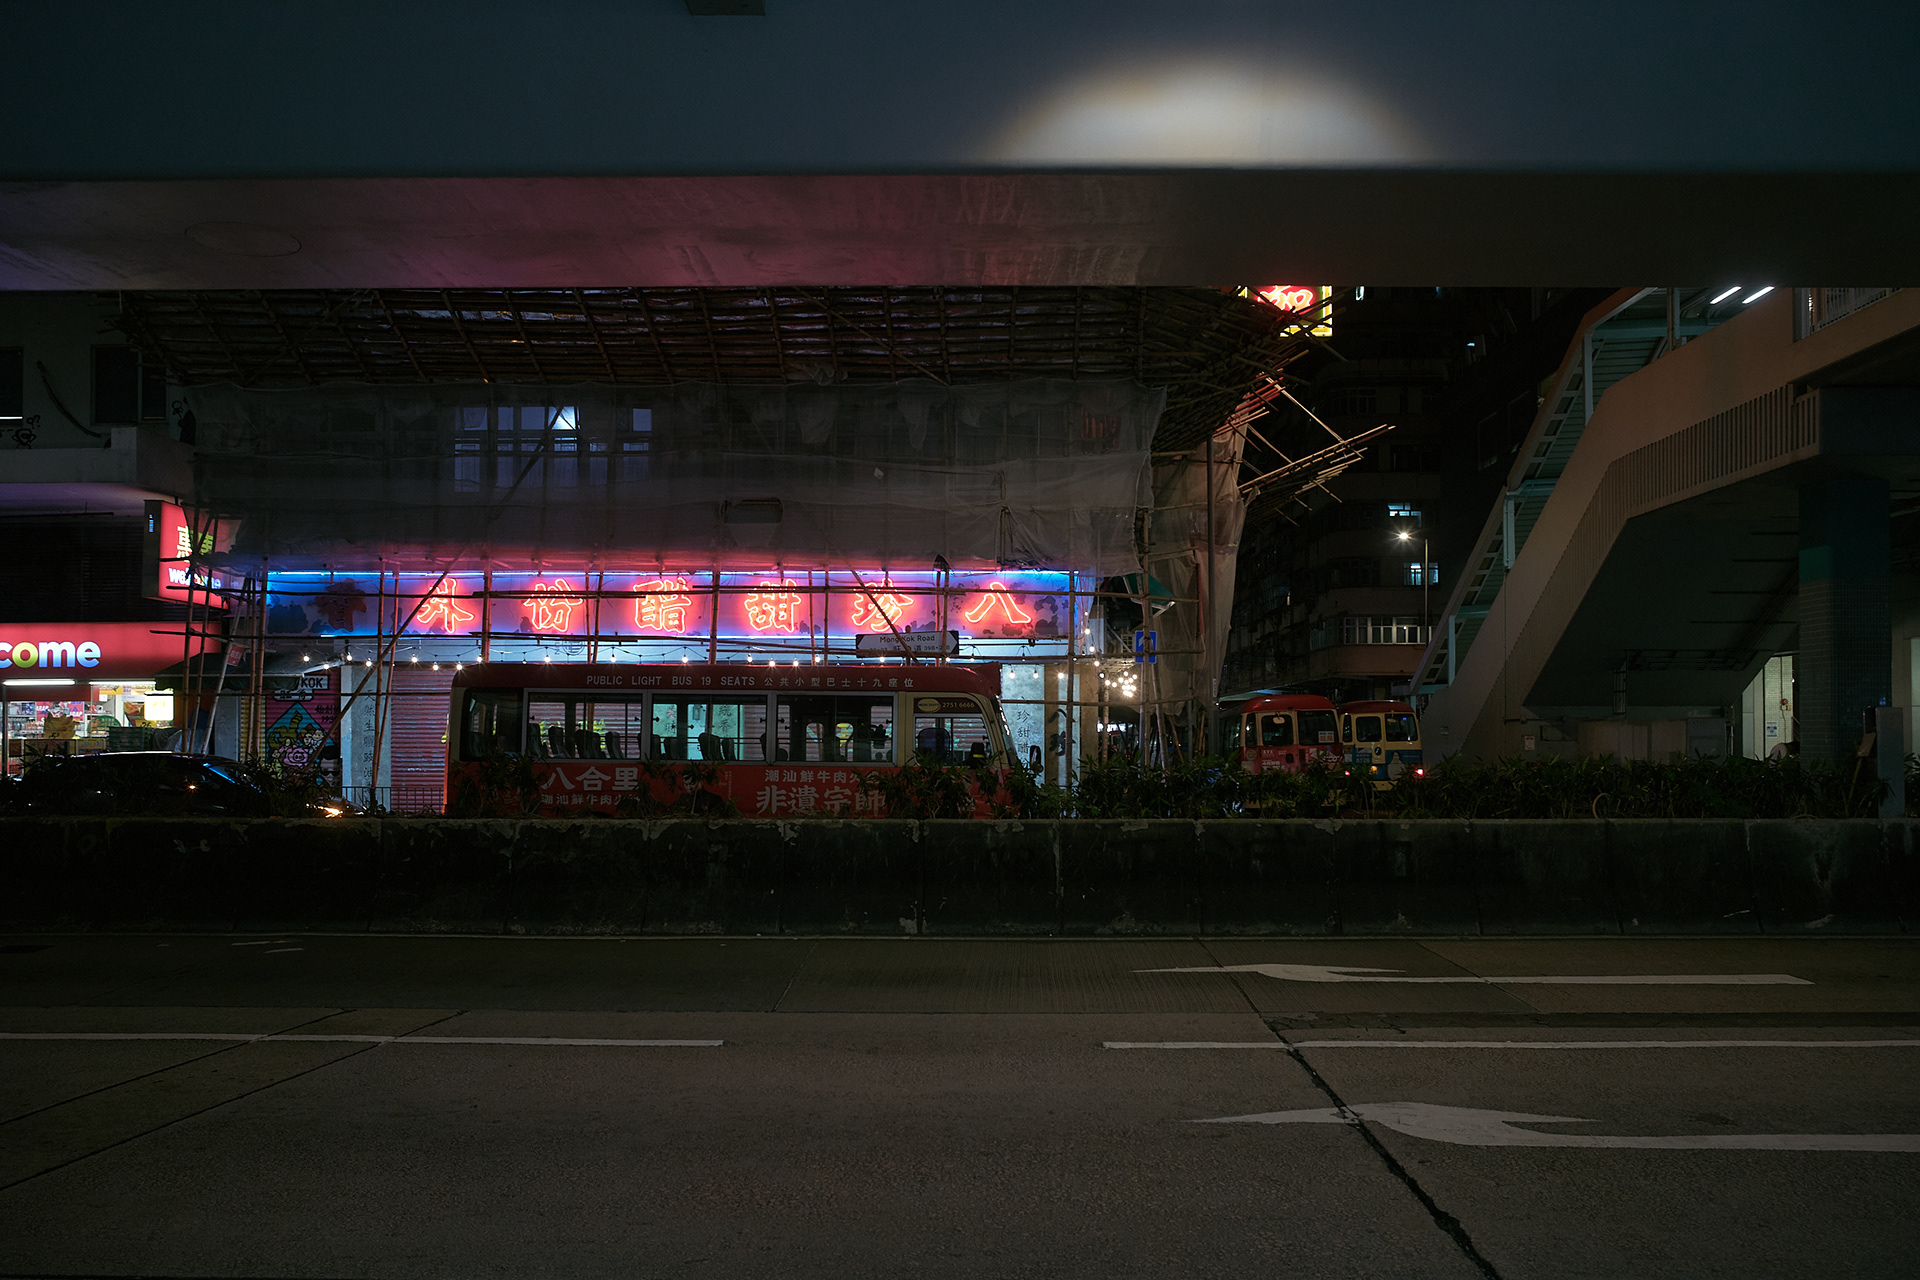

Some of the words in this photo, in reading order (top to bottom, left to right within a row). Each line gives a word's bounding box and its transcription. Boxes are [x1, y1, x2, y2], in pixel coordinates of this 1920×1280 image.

[880, 636, 899, 644] Mong
[917, 634, 935, 642] Road
[0, 641, 101, 669] come
[301, 677, 323, 688] KOK
[586, 675, 623, 686] PUBLIC
[631, 676, 662, 686] LIGHT
[671, 676, 692, 686] BUS
[700, 676, 712, 686] 19
[720, 676, 755, 686] SEATS
[764, 677, 914, 688] 公共小型巴士十九座位
[540, 766, 639, 792] 八合里
